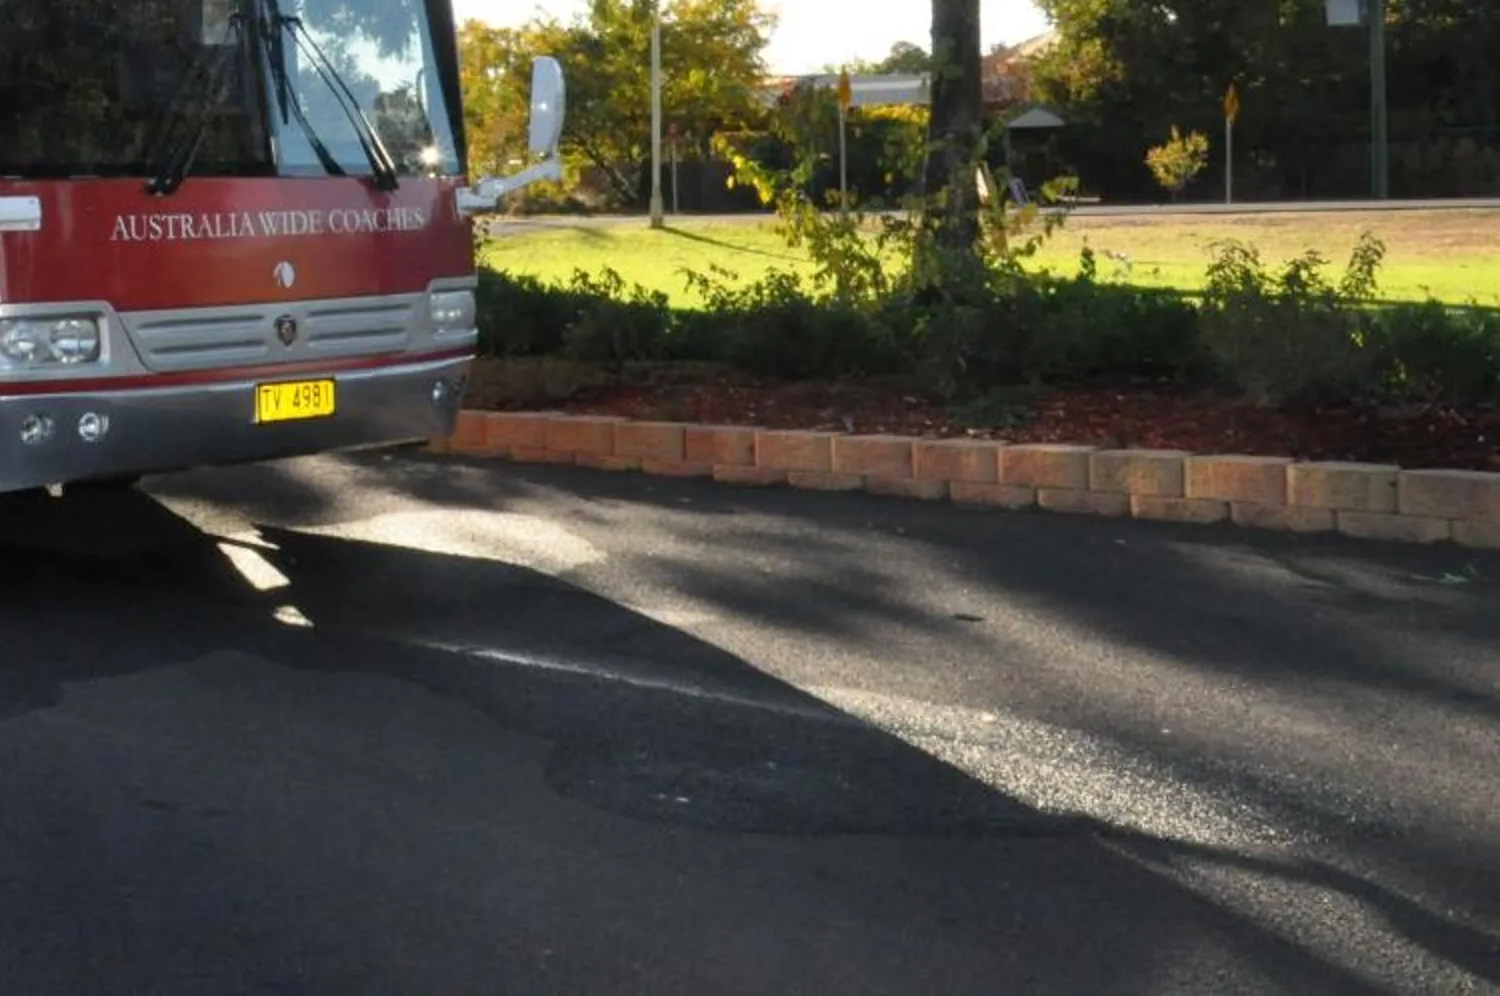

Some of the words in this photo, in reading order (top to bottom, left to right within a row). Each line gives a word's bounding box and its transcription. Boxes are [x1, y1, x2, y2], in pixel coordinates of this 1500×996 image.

[109, 212, 255, 241] AUSTRALIA
[258, 210, 325, 236] WIDE
[328, 206, 426, 233] COACHES
[262, 387, 282, 413] TV
[292, 383, 330, 409] 4981
